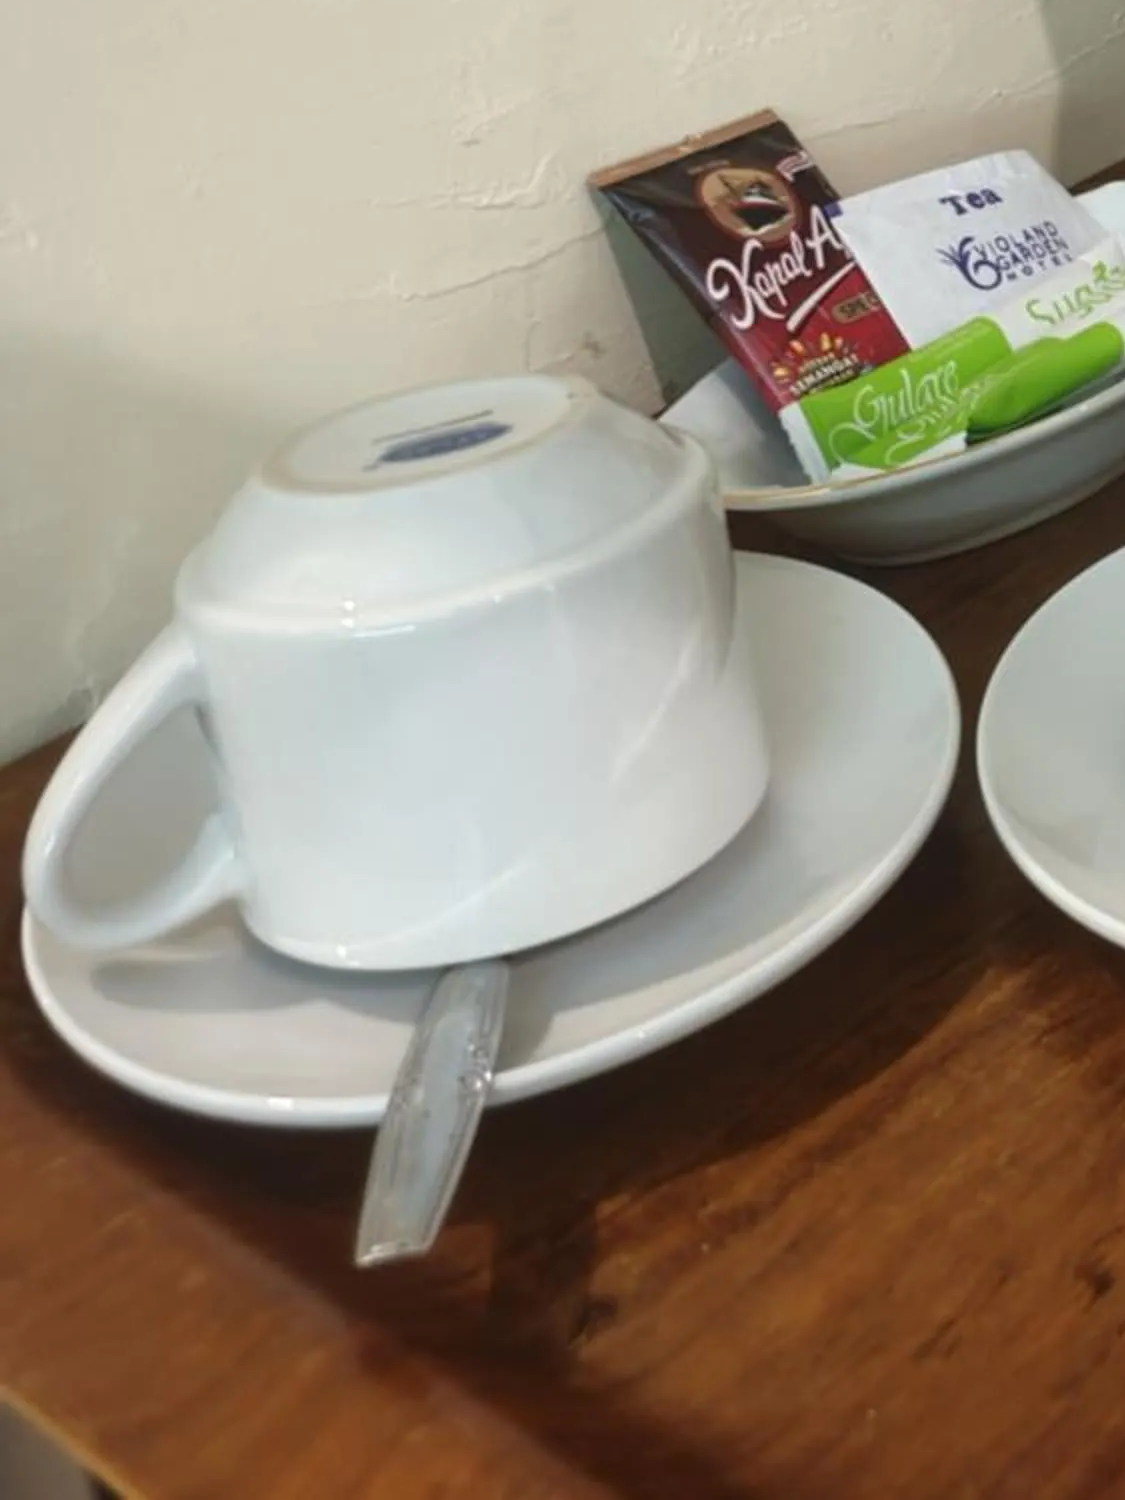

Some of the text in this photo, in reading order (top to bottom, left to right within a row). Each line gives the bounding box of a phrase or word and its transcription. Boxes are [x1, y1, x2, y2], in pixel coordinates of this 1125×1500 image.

[938, 188, 1004, 216] Tea
[995, 238, 1070, 271] GARDEN
[1006, 253, 1073, 281] HOTEL
[706, 238, 813, 330] Kapal
